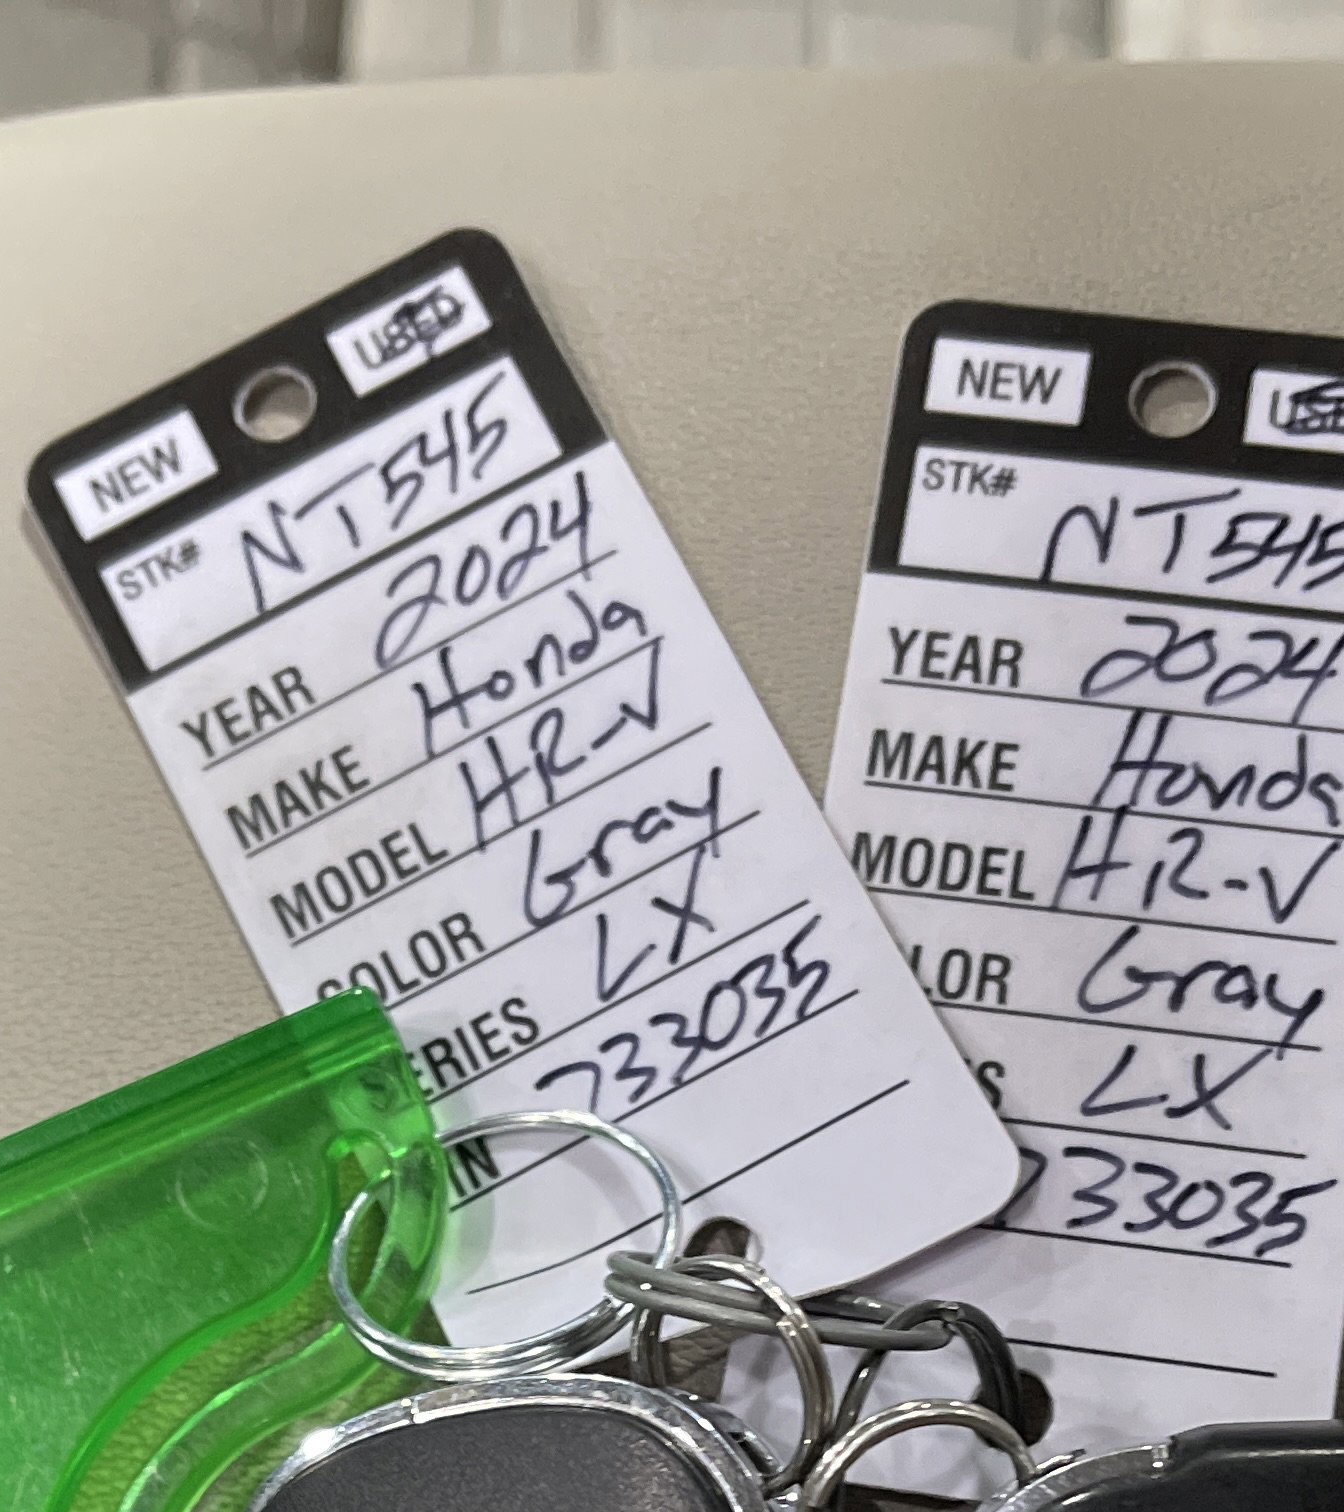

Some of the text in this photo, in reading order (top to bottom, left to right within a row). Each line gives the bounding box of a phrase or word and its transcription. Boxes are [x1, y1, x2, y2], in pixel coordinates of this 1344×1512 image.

[956, 357, 1062, 406] NEW
[89, 440, 181, 512] NEW
[241, 372, 508, 615] NT545
[922, 459, 1017, 495] STK#
[115, 538, 201, 601] STK#
[376, 471, 593, 668] 2024
[180, 665, 317, 757] YEAR
[413, 590, 648, 757] Honda
[888, 625, 1024, 688] YEAR
[224, 744, 370, 850] MAKE
[461, 636, 660, 851] HR-V
[866, 728, 1019, 792] MAKE
[1091, 709, 1344, 827] Honda
[270, 822, 449, 939] MODEL
[525, 767, 721, 928] Gray
[854, 831, 1035, 901] MODEL
[597, 846, 715, 1002] LX
[535, 914, 830, 1109] 733035
[1078, 925, 1325, 1060] Gray
[1080, 1045, 1274, 1130] LX
